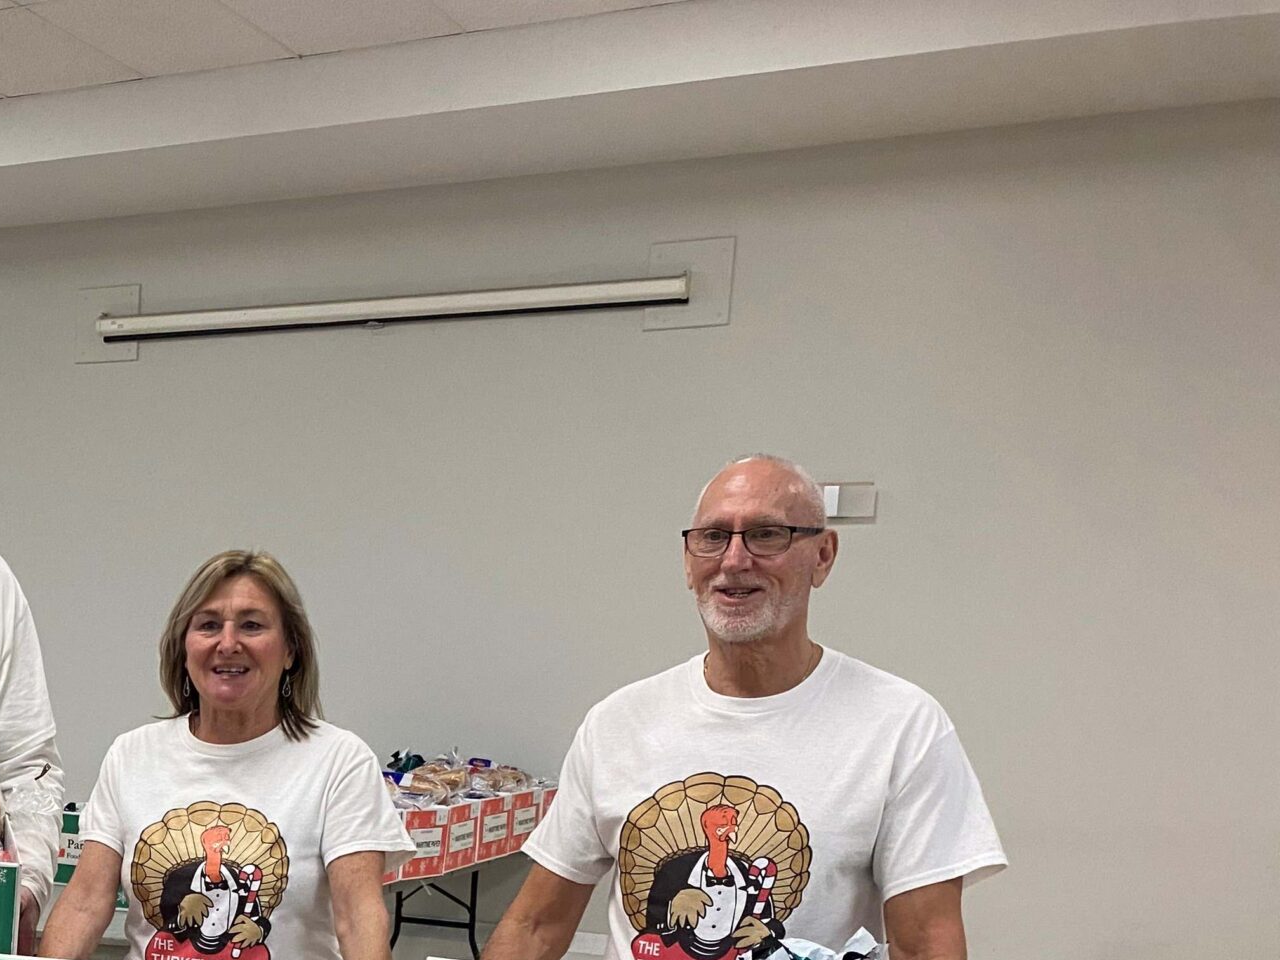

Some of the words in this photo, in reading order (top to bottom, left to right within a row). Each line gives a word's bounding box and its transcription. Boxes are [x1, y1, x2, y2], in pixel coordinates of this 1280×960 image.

[67, 839, 84, 850] Par
[153, 937, 174, 951] THE
[639, 940, 661, 956] THE
